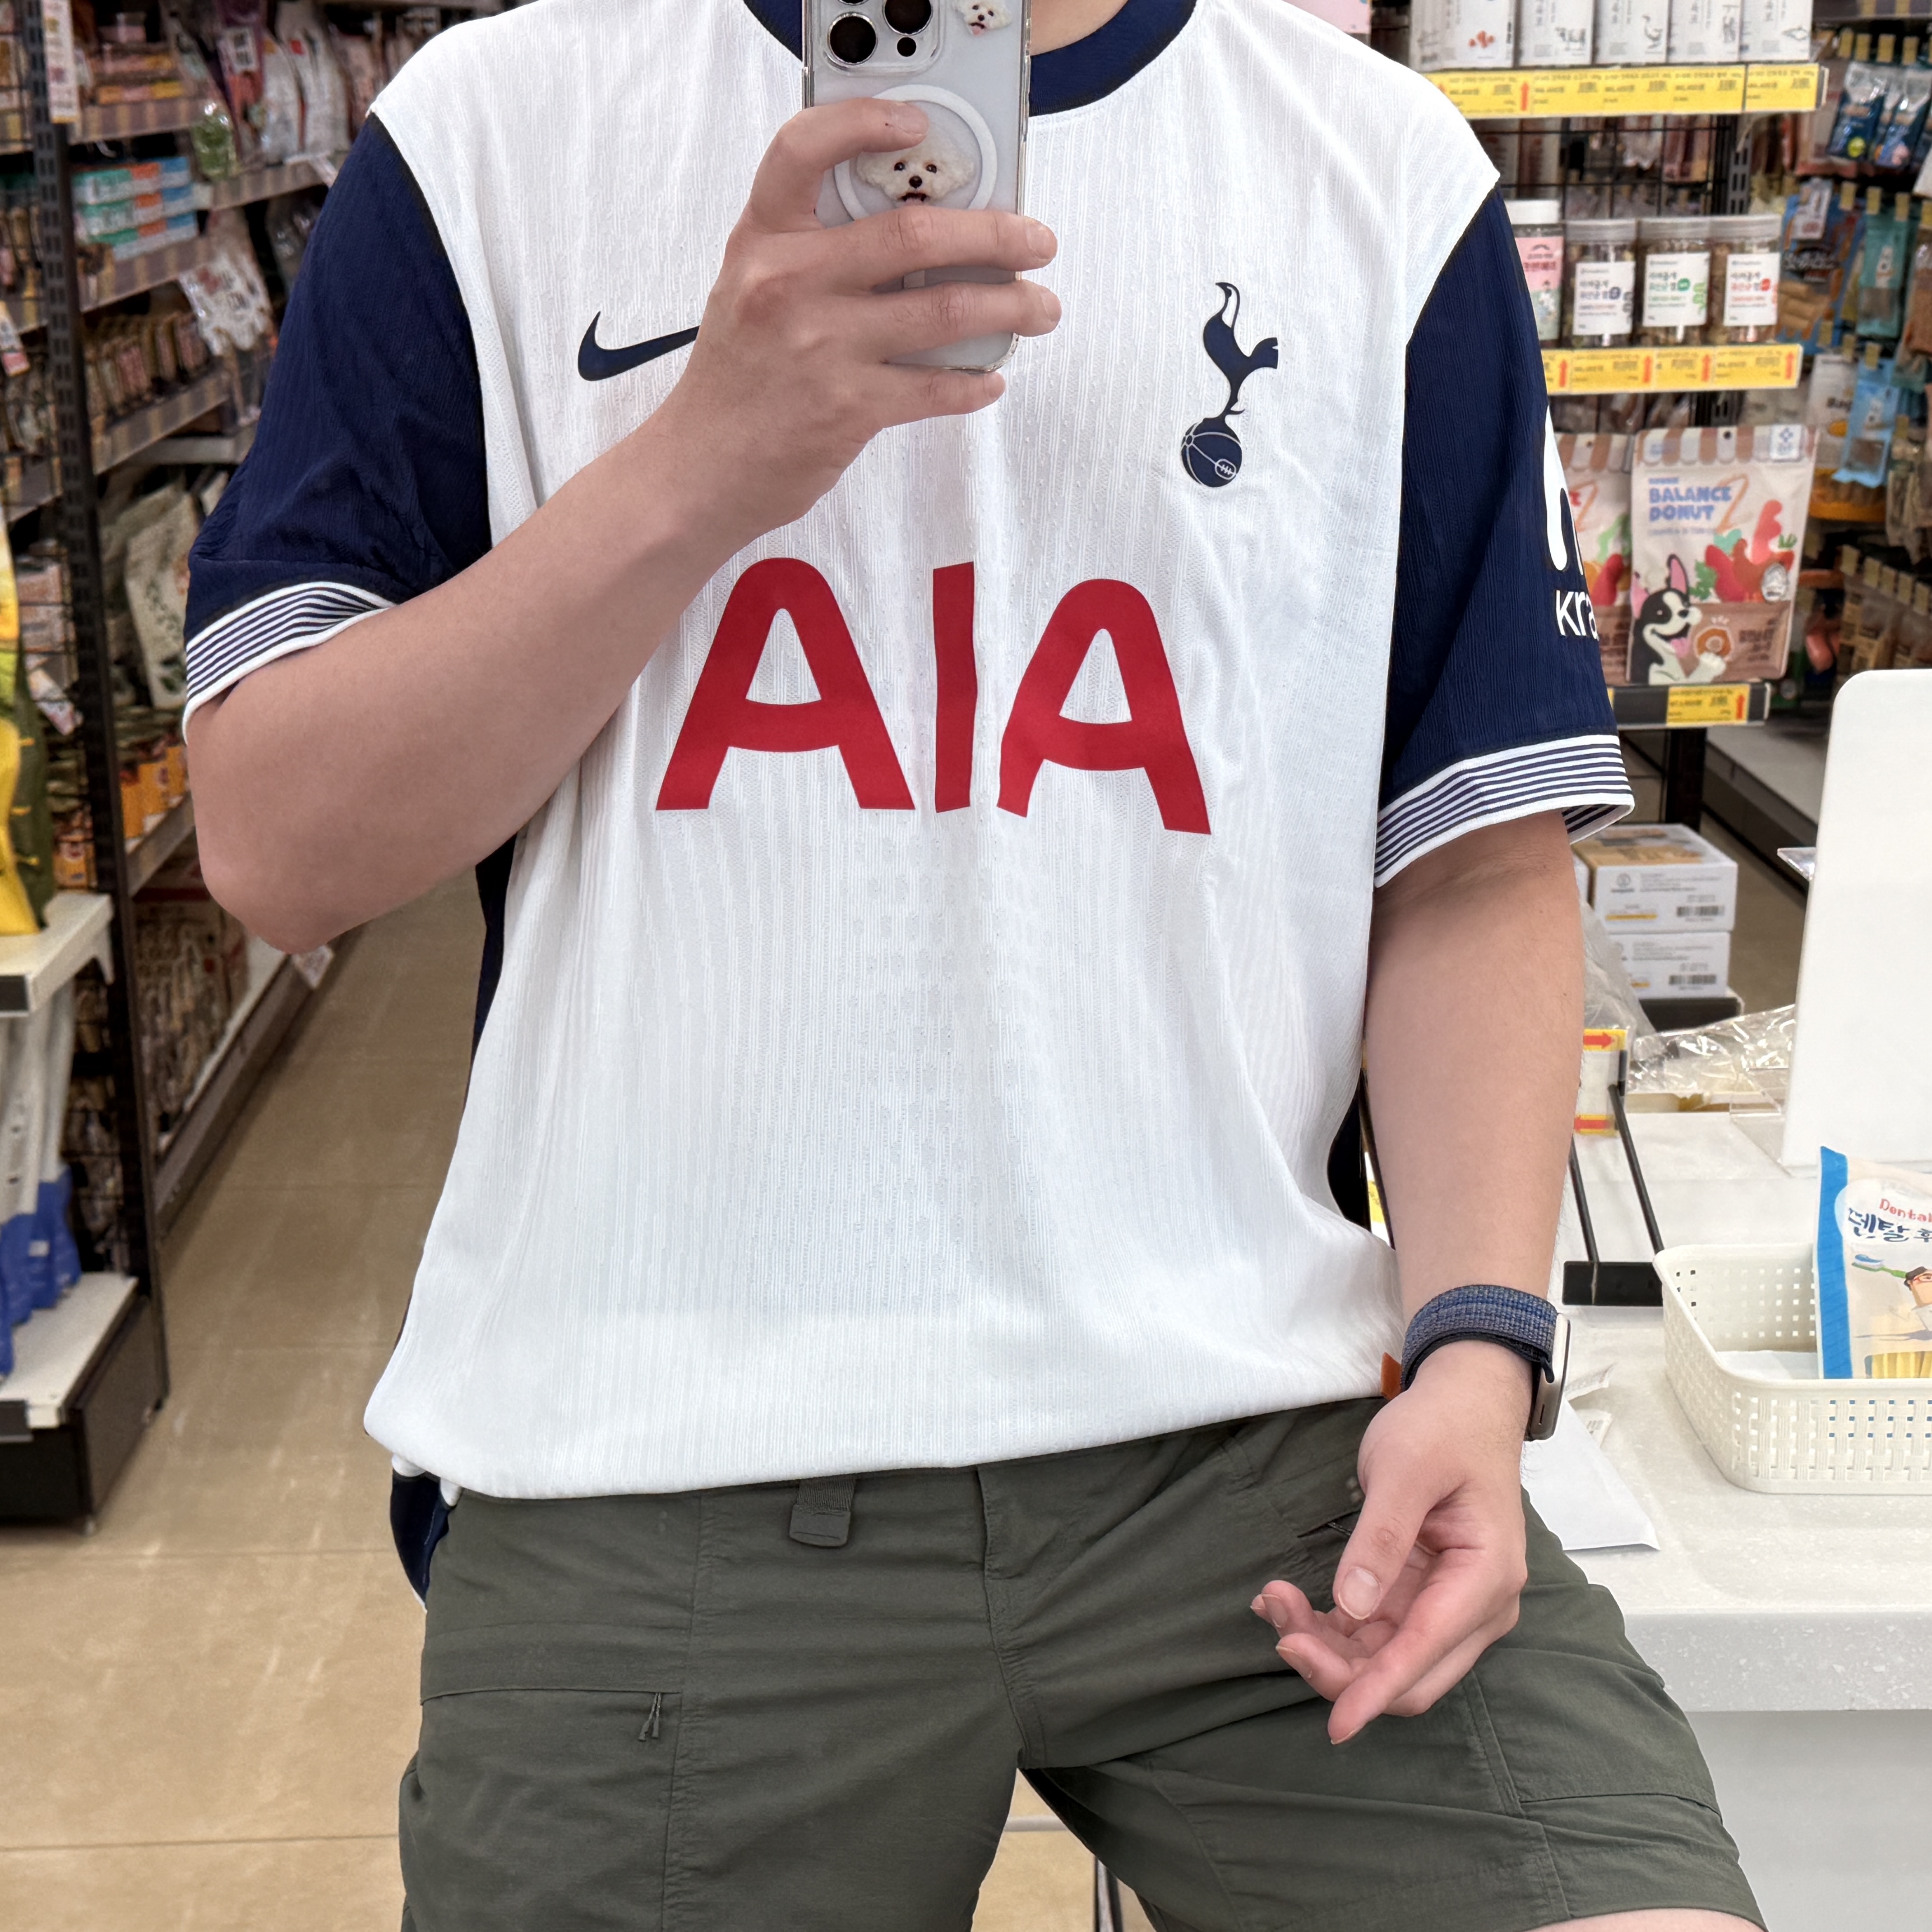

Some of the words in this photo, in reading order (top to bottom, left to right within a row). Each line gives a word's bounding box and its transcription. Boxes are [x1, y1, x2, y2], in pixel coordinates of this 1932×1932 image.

[1649, 486, 1732, 503] BALANCE
[1650, 504, 1715, 522] DONUT
[656, 557, 1211, 835] AIA
[1879, 1198, 1932, 1223] Dental
